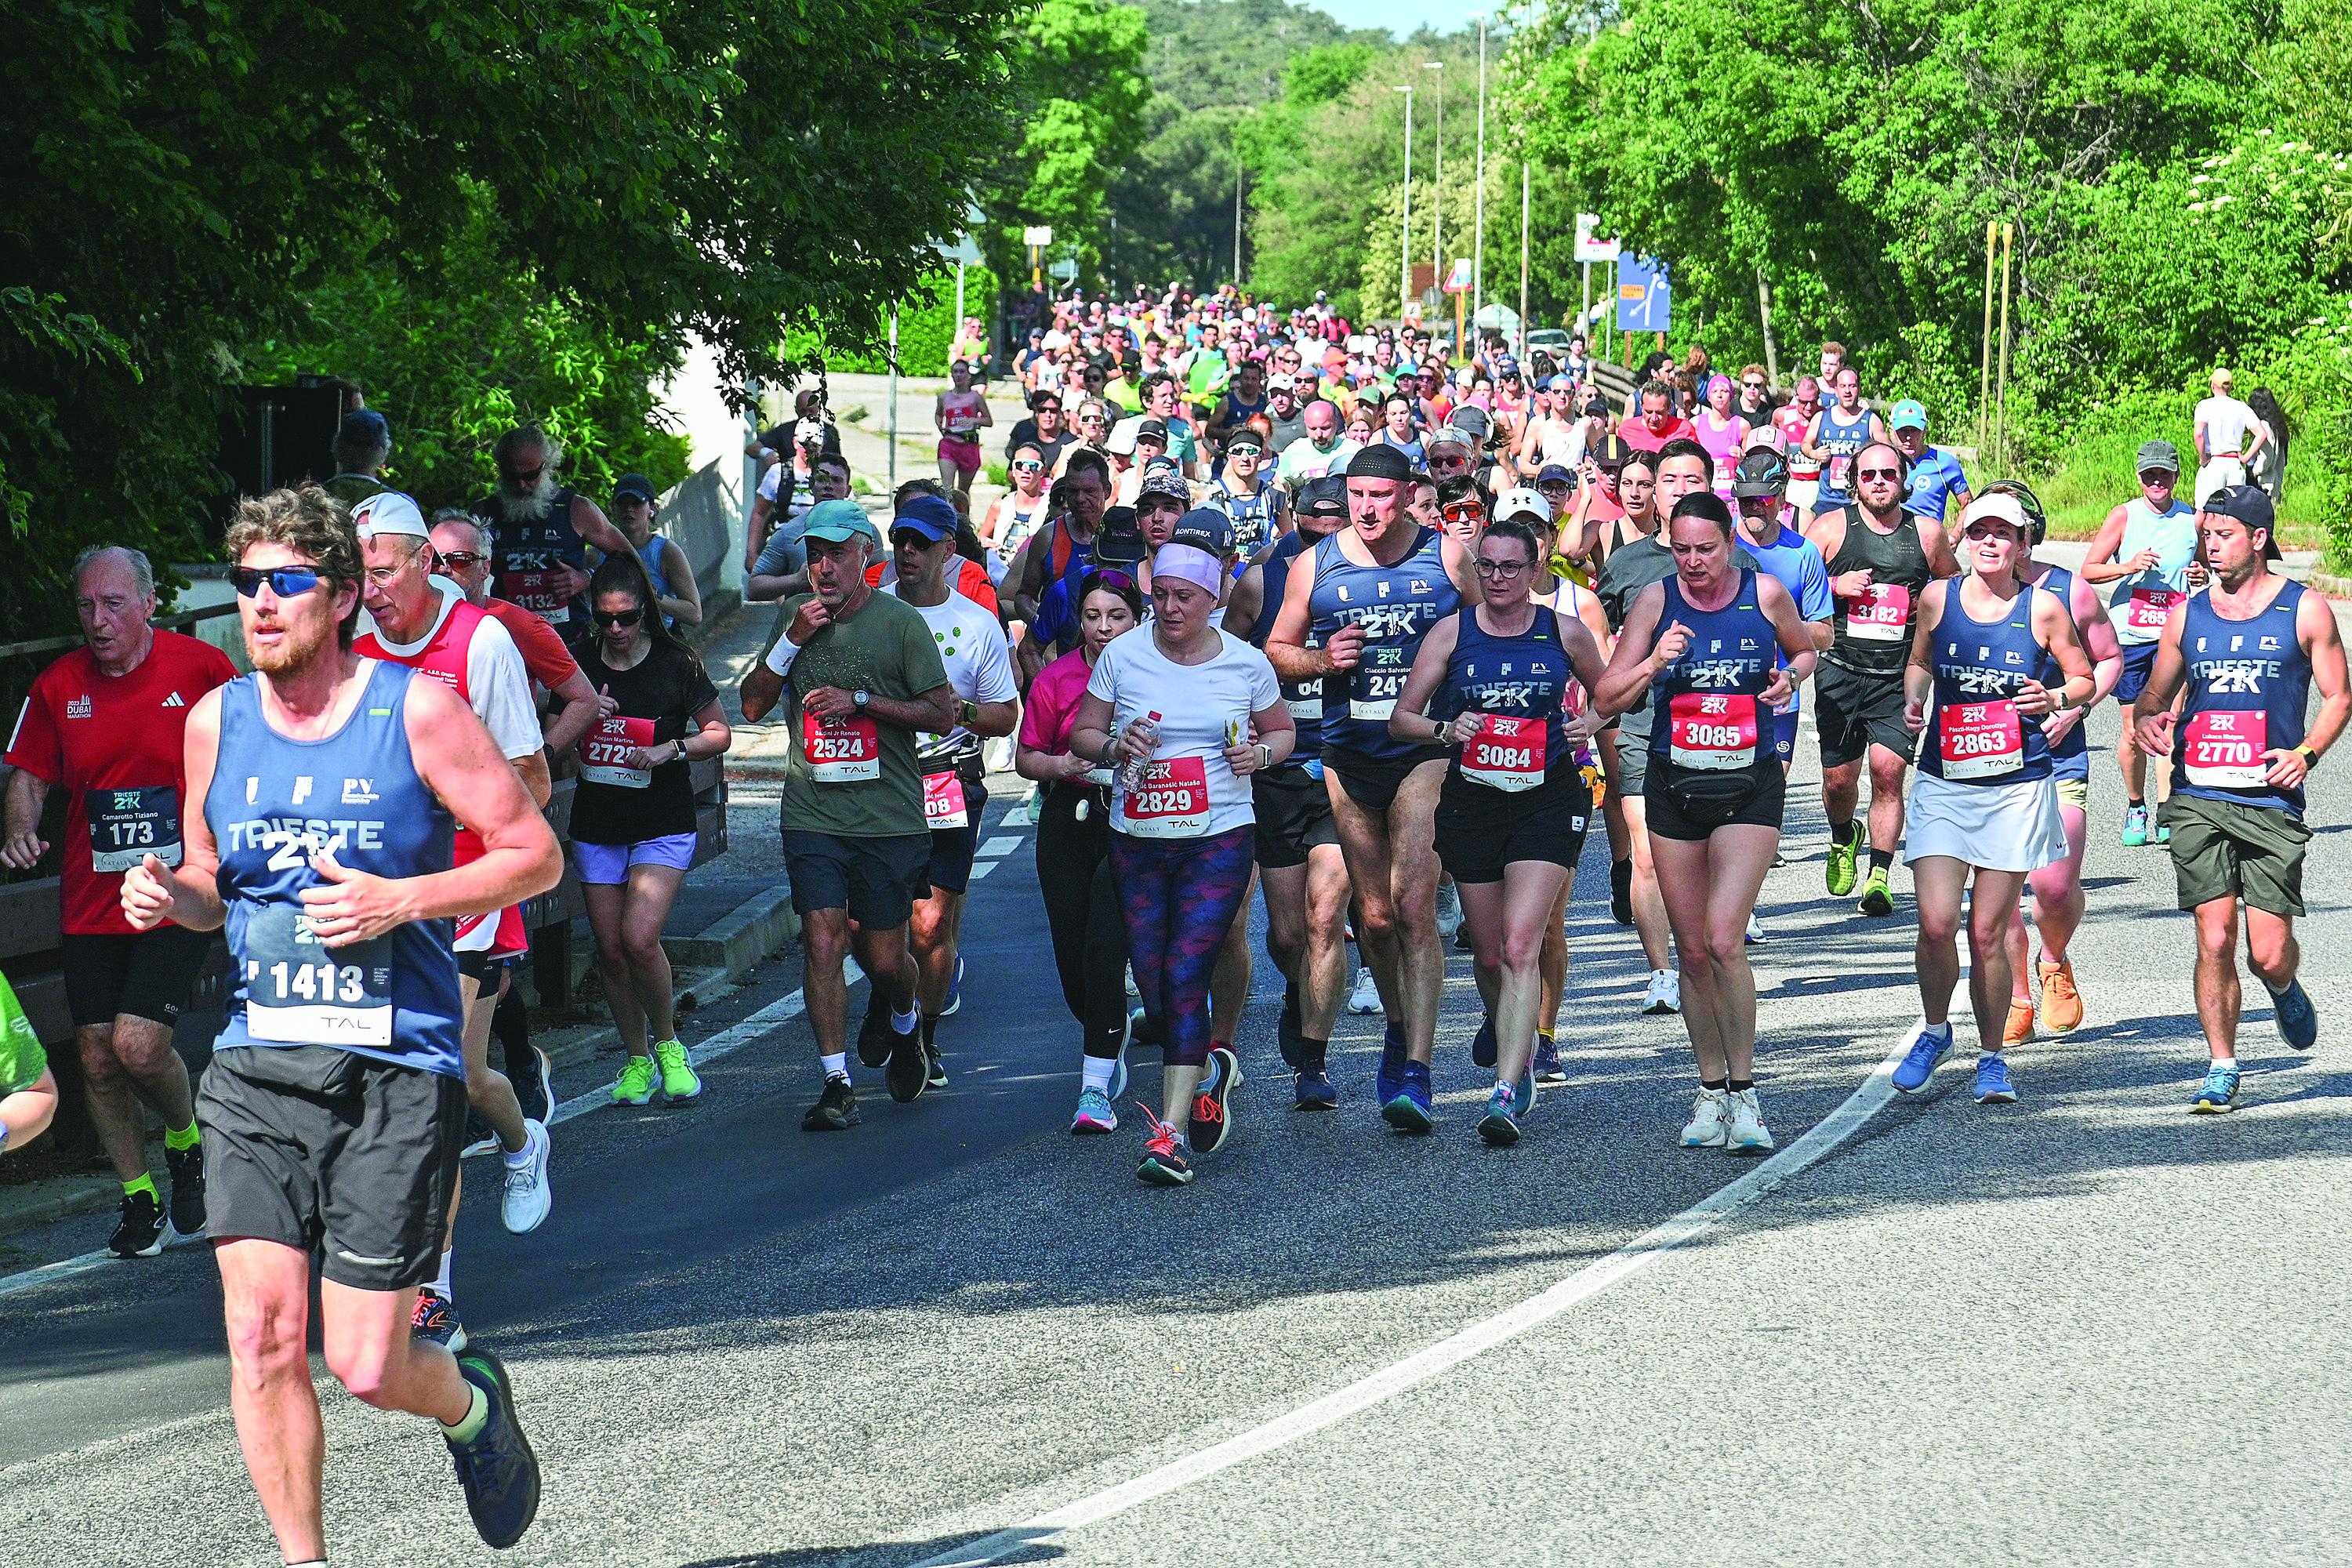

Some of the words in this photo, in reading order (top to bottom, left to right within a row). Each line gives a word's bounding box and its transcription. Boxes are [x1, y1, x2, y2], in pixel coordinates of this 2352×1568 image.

[506, 553, 547, 571] 21K
[516, 593, 557, 608] 3132
[1333, 603, 1437, 627] TRIESTE
[1857, 604, 1898, 622] 3182
[2138, 609, 2170, 626] 265
[1359, 612, 1416, 638] 21K
[1377, 653, 1402, 665] 21K
[1667, 659, 1762, 678] TRIESTE
[1690, 666, 1740, 688] 21K
[1939, 664, 2027, 687] TRIESTE
[2191, 659, 2281, 679] TRIESTE
[1461, 681, 1552, 699] TRIESTE
[1958, 673, 2005, 695] 21K
[2209, 668, 2261, 694] 21K
[1481, 688, 1530, 708] 21K
[67, 705, 92, 714] DUBAI
[1701, 702, 1728, 713] 21K
[1962, 710, 1987, 723] 21K
[603, 723, 625, 735] 21K
[1493, 723, 1519, 737] 21K
[1686, 722, 1740, 747] 3085
[813, 738, 864, 758] 2524
[1951, 731, 2007, 755] 2863
[1476, 744, 1531, 768] 3084
[1715, 754, 1744, 763] TAL
[2197, 741, 2252, 764] 2770
[840, 765, 870, 774] TAL
[1984, 759, 2013, 768] TAL
[614, 771, 642, 781] TAL
[1146, 767, 1172, 779] 21K
[343, 778, 374, 794] PV
[114, 797, 141, 810] 21K
[924, 797, 951, 816] 08
[1136, 789, 1192, 813] 2829
[109, 821, 154, 845] 173
[227, 818, 385, 851] TRIESTE
[270, 961, 365, 1003] 1413
[321, 1017, 371, 1029] TAL
